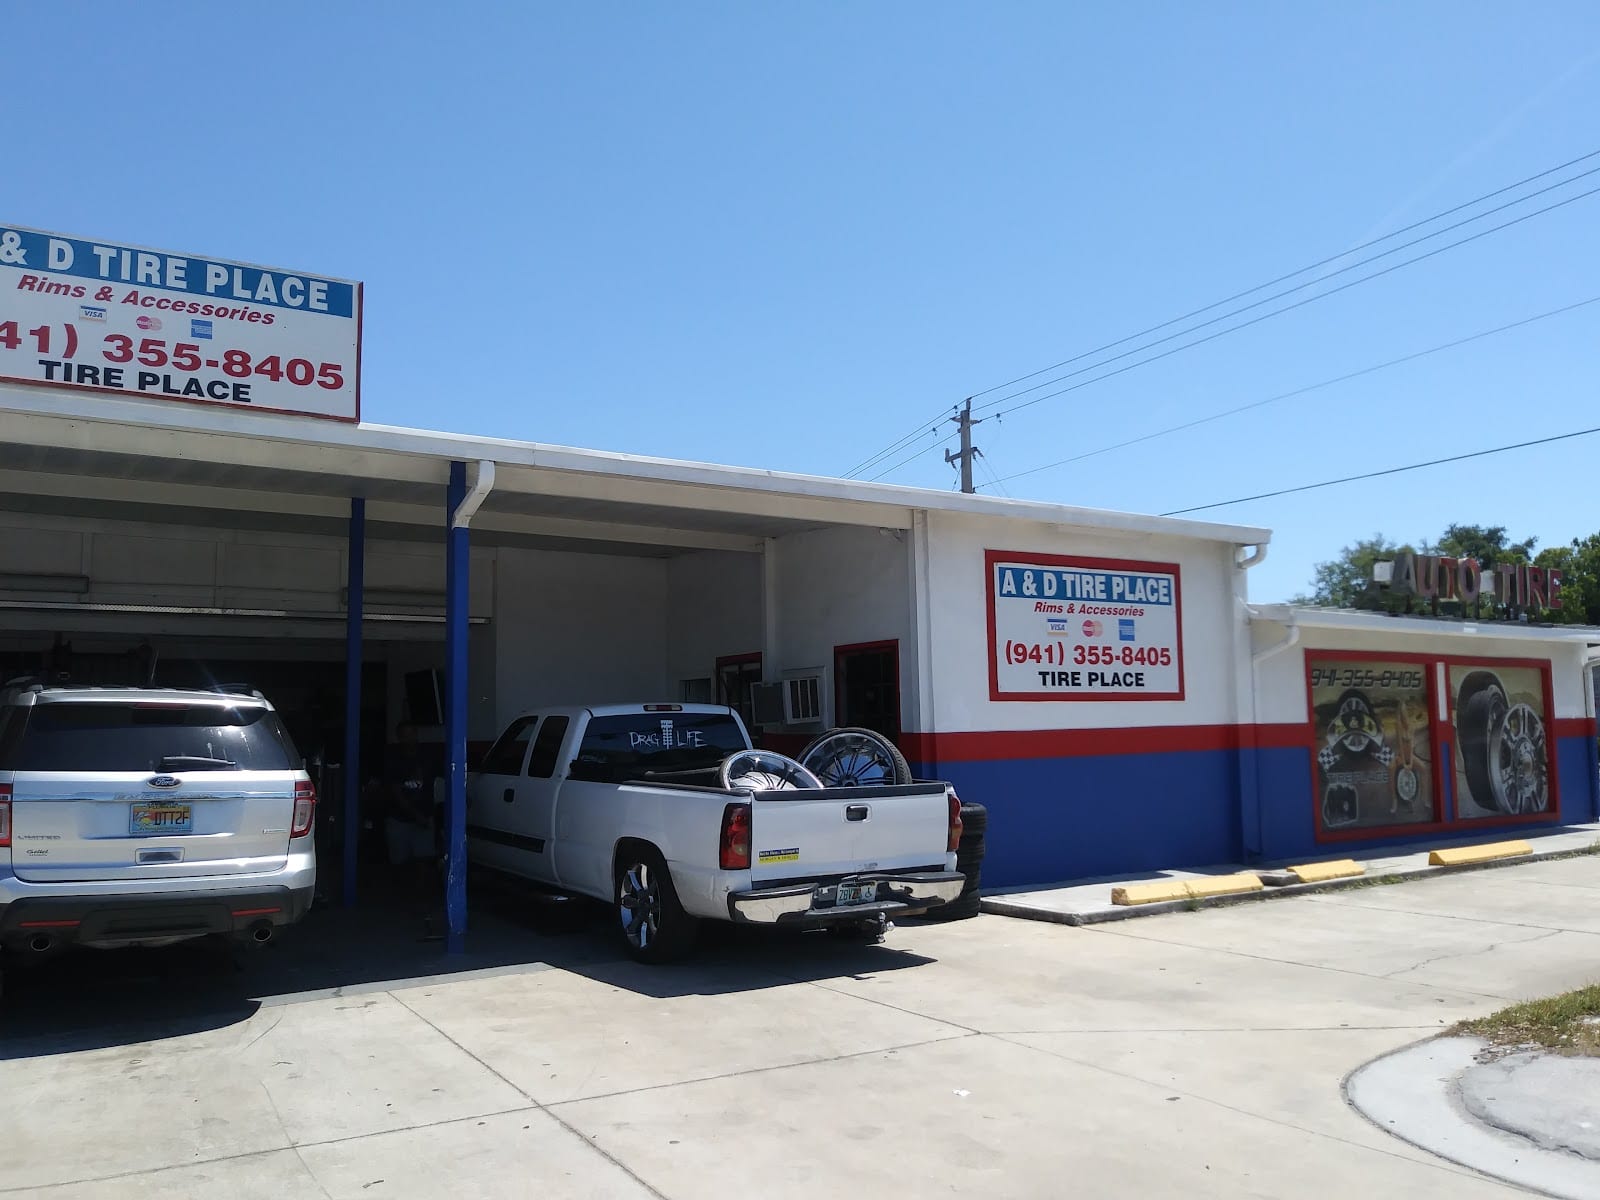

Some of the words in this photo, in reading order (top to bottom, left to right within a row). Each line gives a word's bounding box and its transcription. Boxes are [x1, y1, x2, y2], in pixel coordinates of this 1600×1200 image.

[0, 231, 28, 265] &
[48, 239, 74, 271] D
[93, 245, 187, 289] TIRE
[206, 264, 329, 311] PLACE
[17, 275, 86, 299] Rims
[95, 285, 114, 302] &
[121, 290, 276, 325] Accessories
[84, 310, 103, 318] VISA
[102, 334, 344, 390] 355-8405
[39, 360, 124, 388] TIRE
[138, 371, 251, 403] PLACE
[1002, 569, 1016, 595] A
[1022, 570, 1037, 596] &
[1043, 571, 1057, 597] D
[1062, 573, 1106, 600] TIRE
[1112, 576, 1170, 603] PLACE
[1392, 553, 1481, 602] AUTO
[1496, 562, 1562, 609] TIRE
[1034, 602, 1063, 614] Rims
[1067, 603, 1074, 614] &
[1078, 604, 1144, 617] Accessories
[1005, 640, 1064, 665] (941)
[1073, 645, 1171, 666] 355-8405
[1038, 671, 1081, 686] TIRE
[1088, 672, 1145, 687] PLACE
[1311, 669, 1421, 688] 941-355-8405
[629, 732, 659, 749] DRAG
[676, 730, 708, 747] LIFE
[155, 777, 175, 786] Ford
